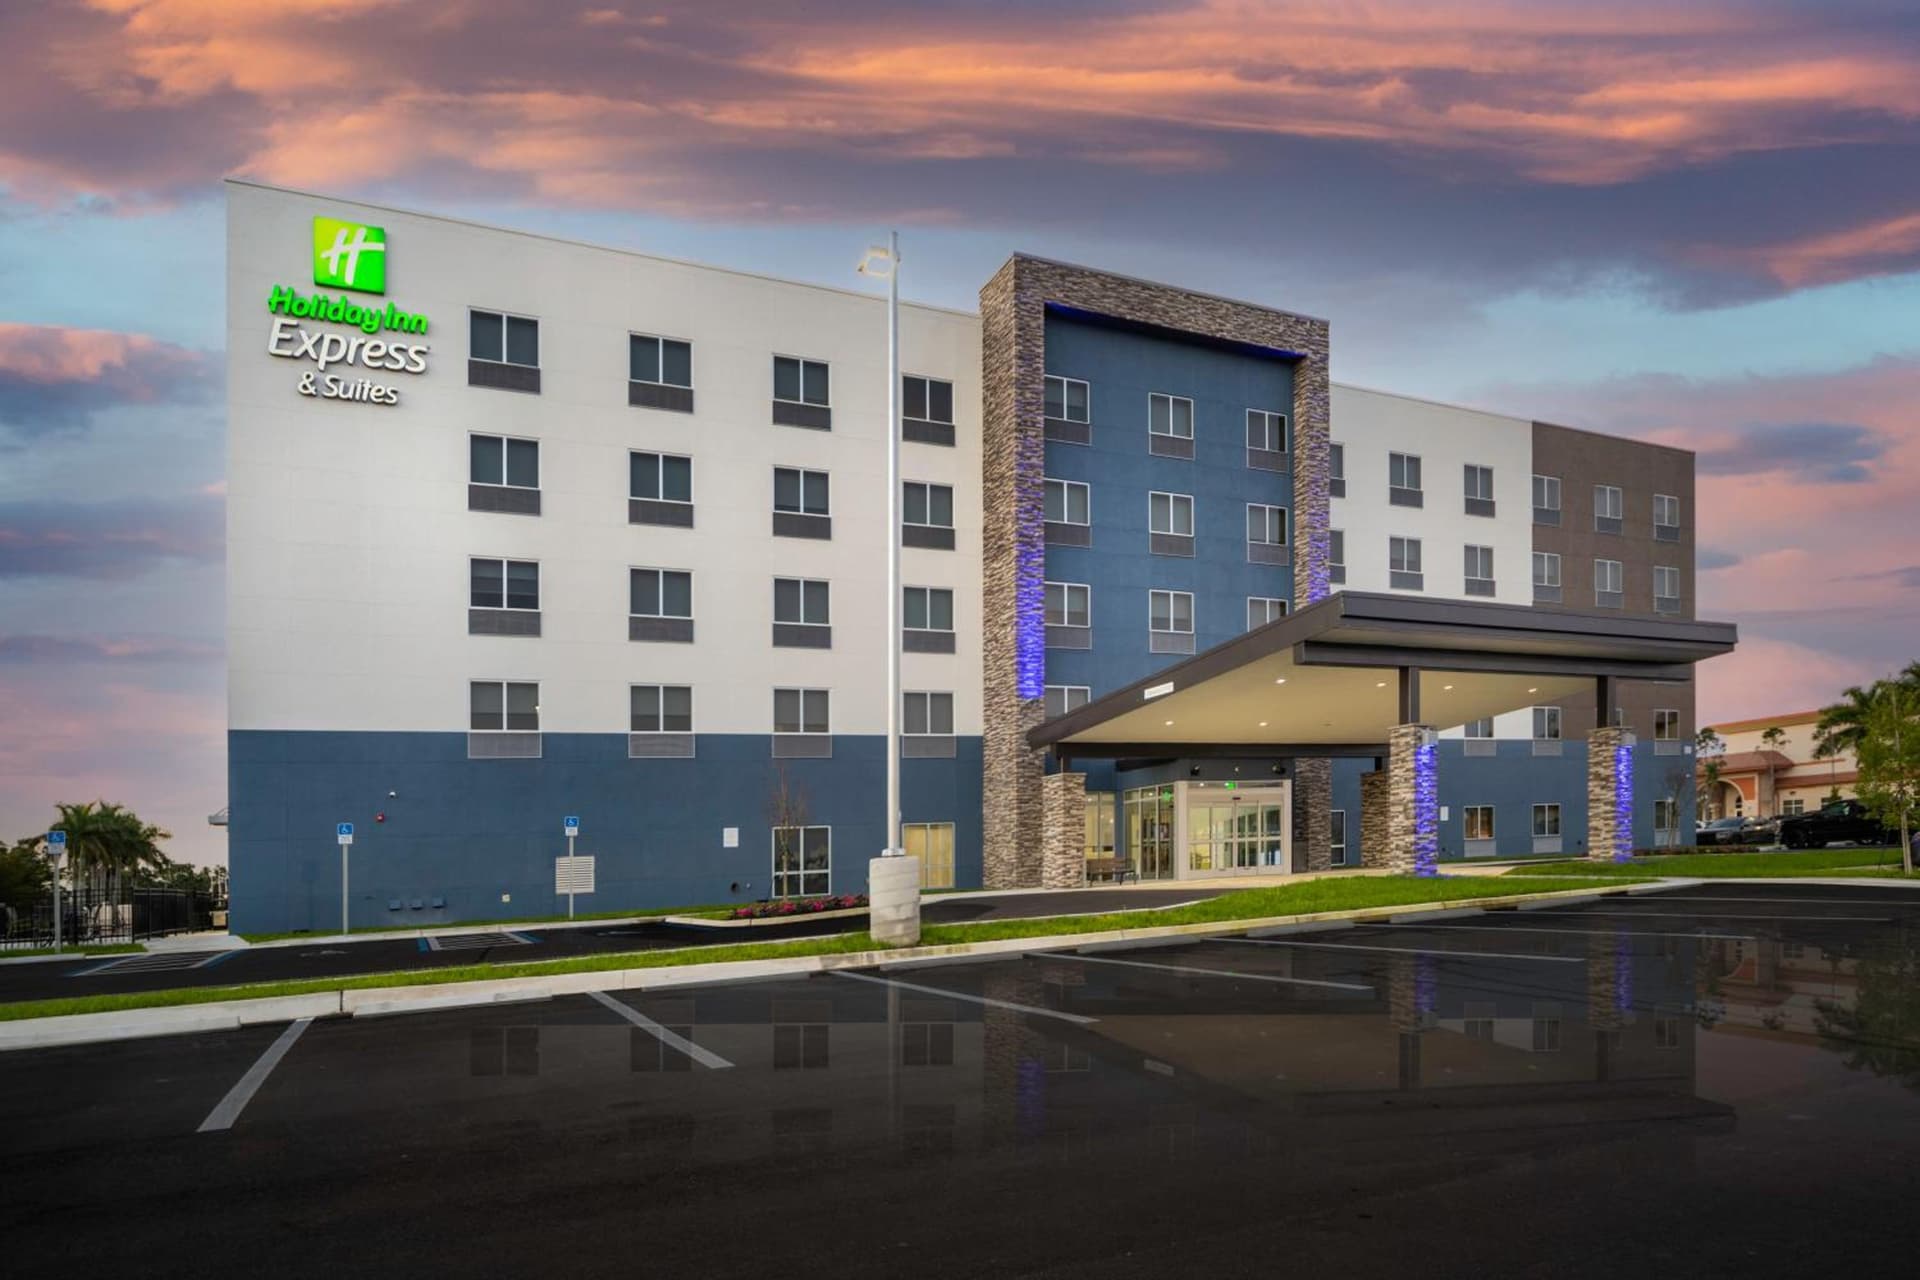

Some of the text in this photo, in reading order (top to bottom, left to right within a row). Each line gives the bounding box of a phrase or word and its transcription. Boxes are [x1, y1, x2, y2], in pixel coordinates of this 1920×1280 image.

[268, 284, 428, 335] Holiday Inn
[268, 317, 427, 374] Express
[297, 371, 399, 404] & Suites
